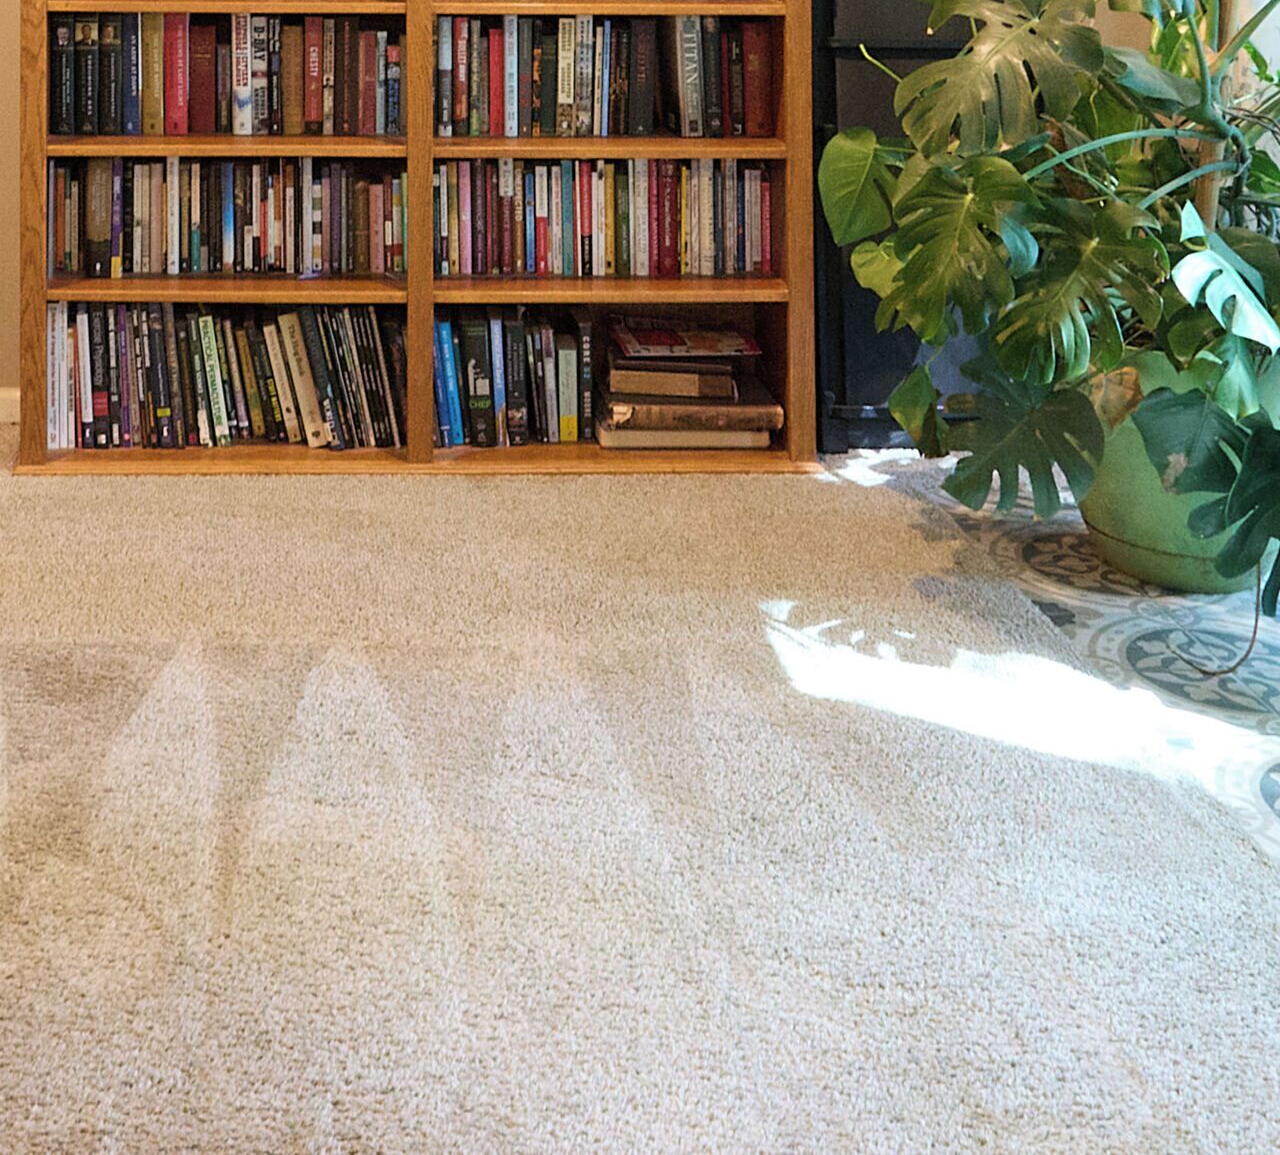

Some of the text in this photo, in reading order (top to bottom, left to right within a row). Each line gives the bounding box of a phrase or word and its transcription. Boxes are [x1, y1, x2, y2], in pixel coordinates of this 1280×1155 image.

[254, 26, 266, 62] D-DAY
[310, 46, 318, 76] CHESTY
[684, 30, 698, 84] TITAN
[92, 345, 104, 386] Physiology
[582, 335, 590, 363] CORE
[202, 320, 222, 426] PRACTICAL PERMACULTURE
[469, 398, 491, 410] CHEF
